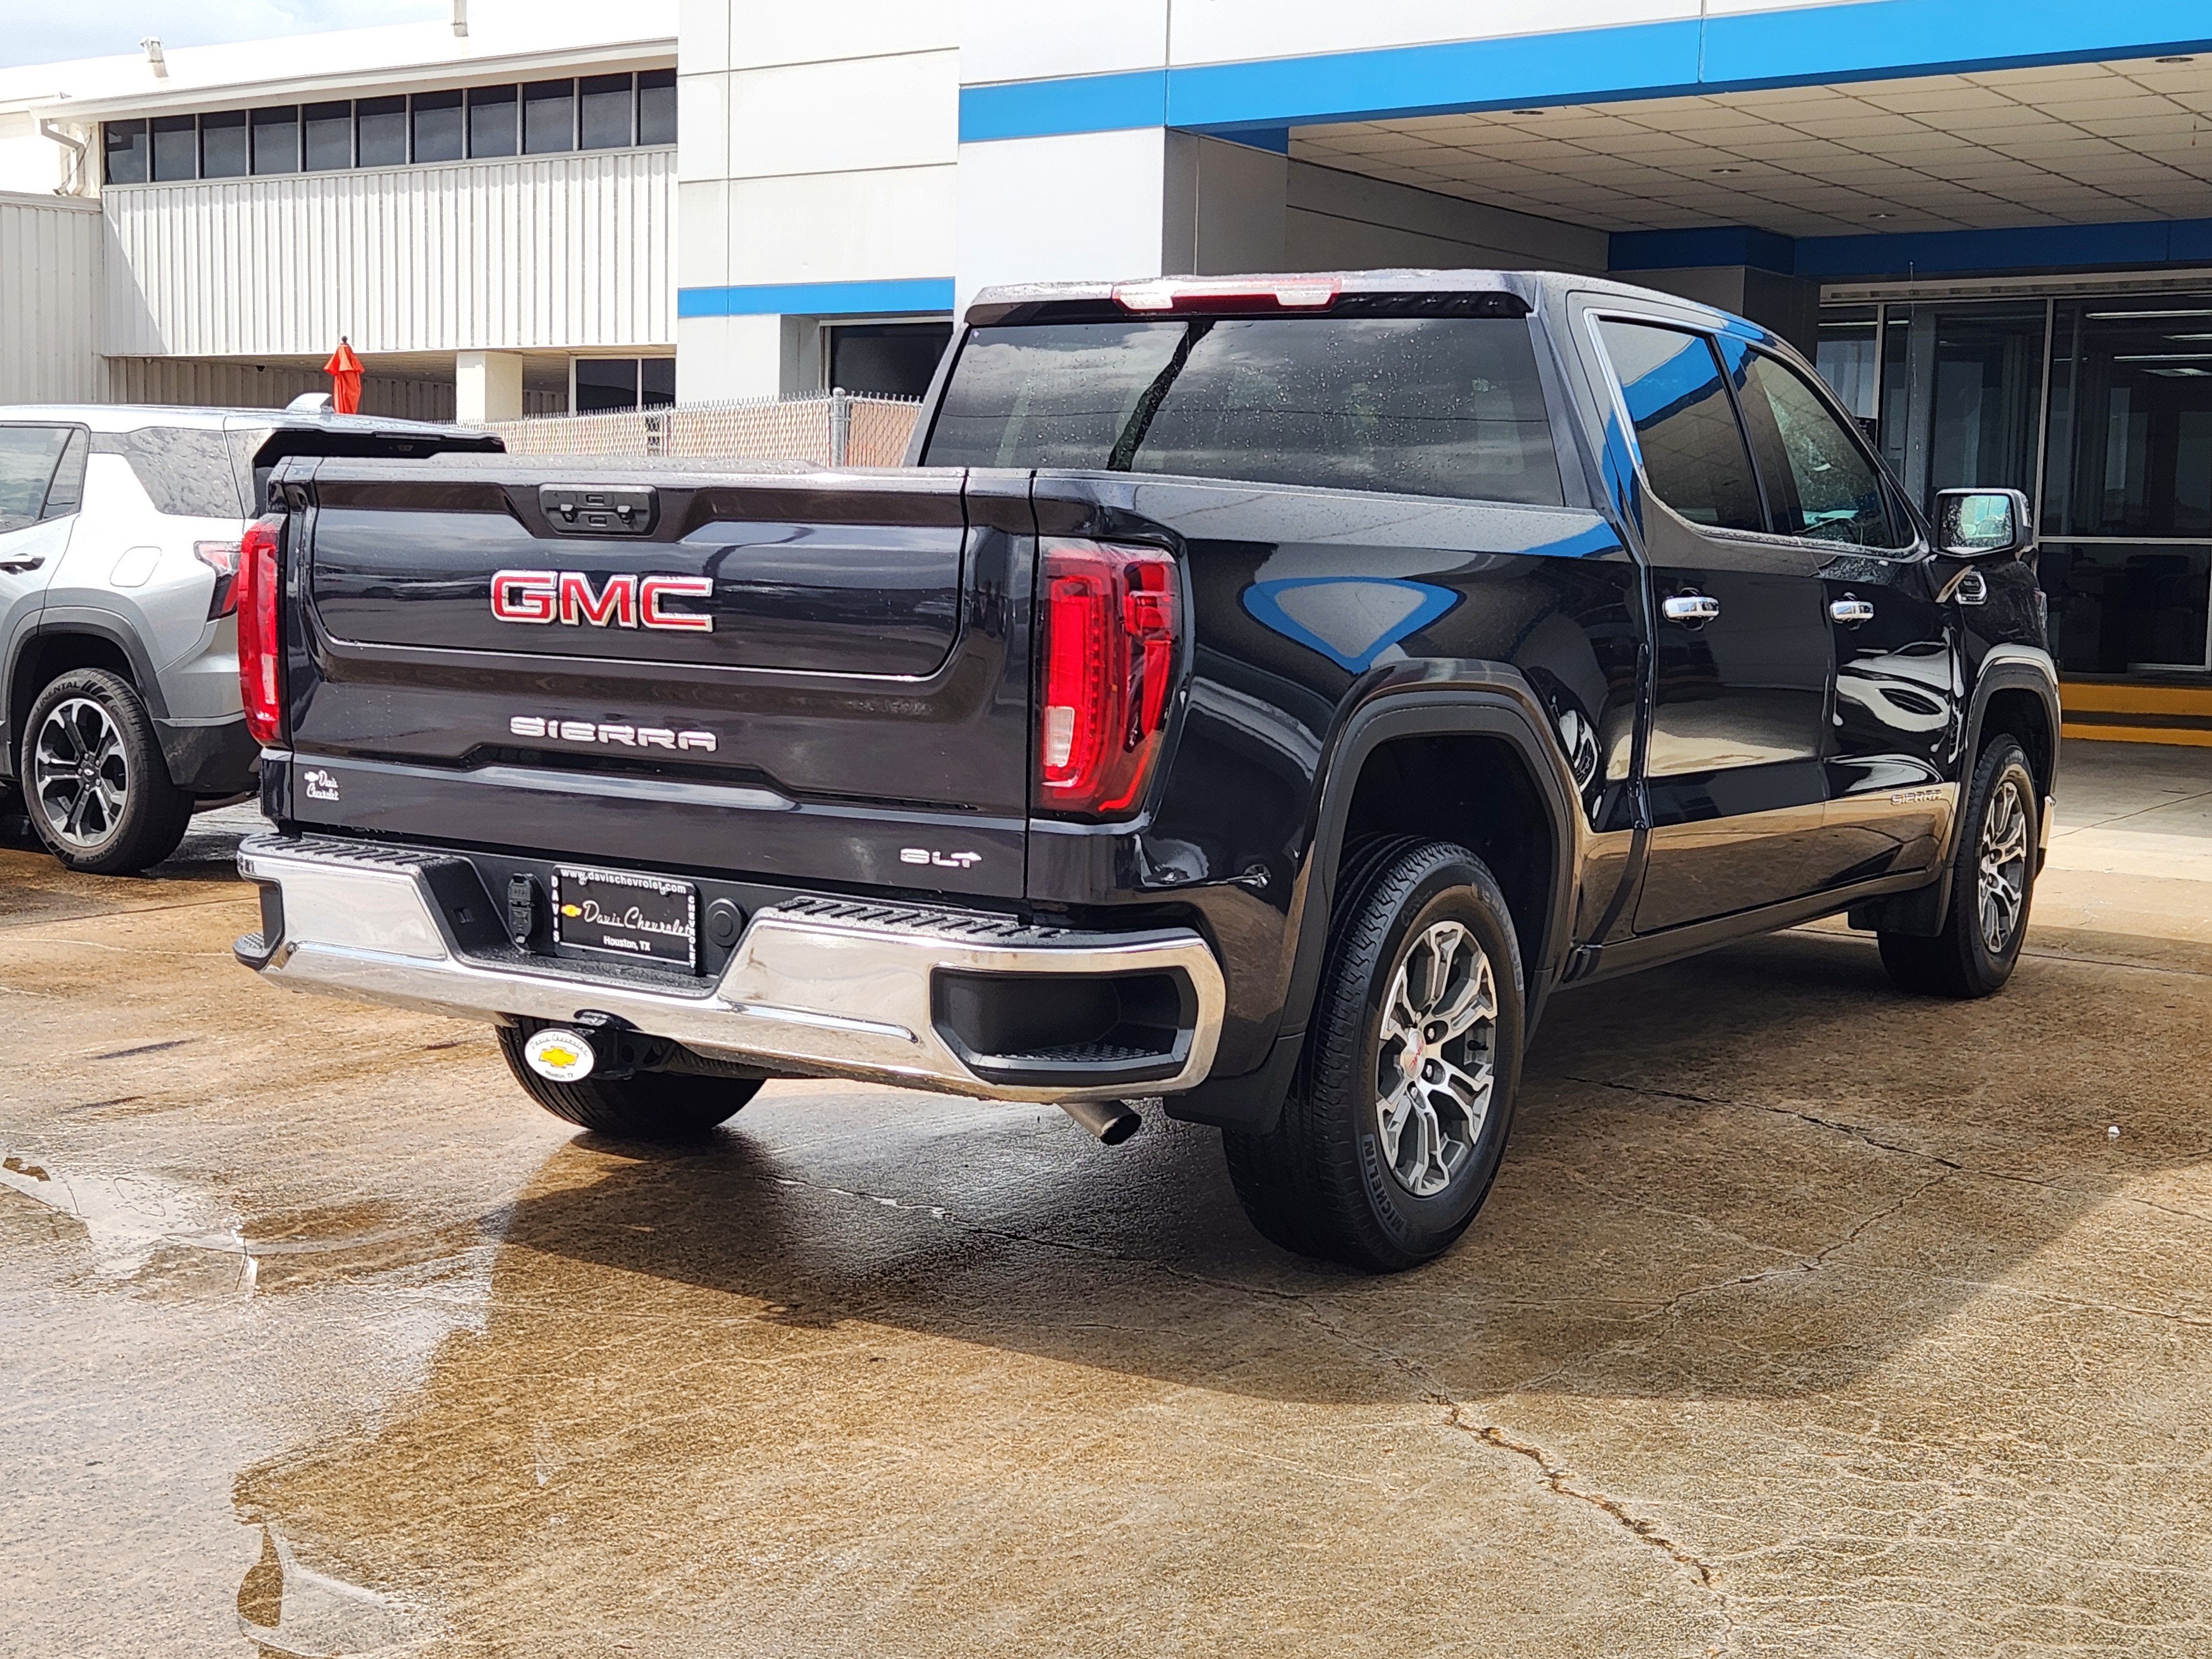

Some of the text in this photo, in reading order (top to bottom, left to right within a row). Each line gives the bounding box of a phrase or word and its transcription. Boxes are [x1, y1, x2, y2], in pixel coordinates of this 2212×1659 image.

[491, 570, 713, 633] GMC
[510, 716, 717, 752] SIERRA
[900, 848, 982, 868] SLT
[560, 869, 687, 894] www.davischevrolet.com
[550, 875, 560, 943] DAVIS
[582, 900, 691, 937] Davis Chevrolet
[603, 935, 651, 952] Houston, TX
[687, 895, 697, 969] CHEVROLET
[1364, 1140, 1405, 1233] MICHELIN
